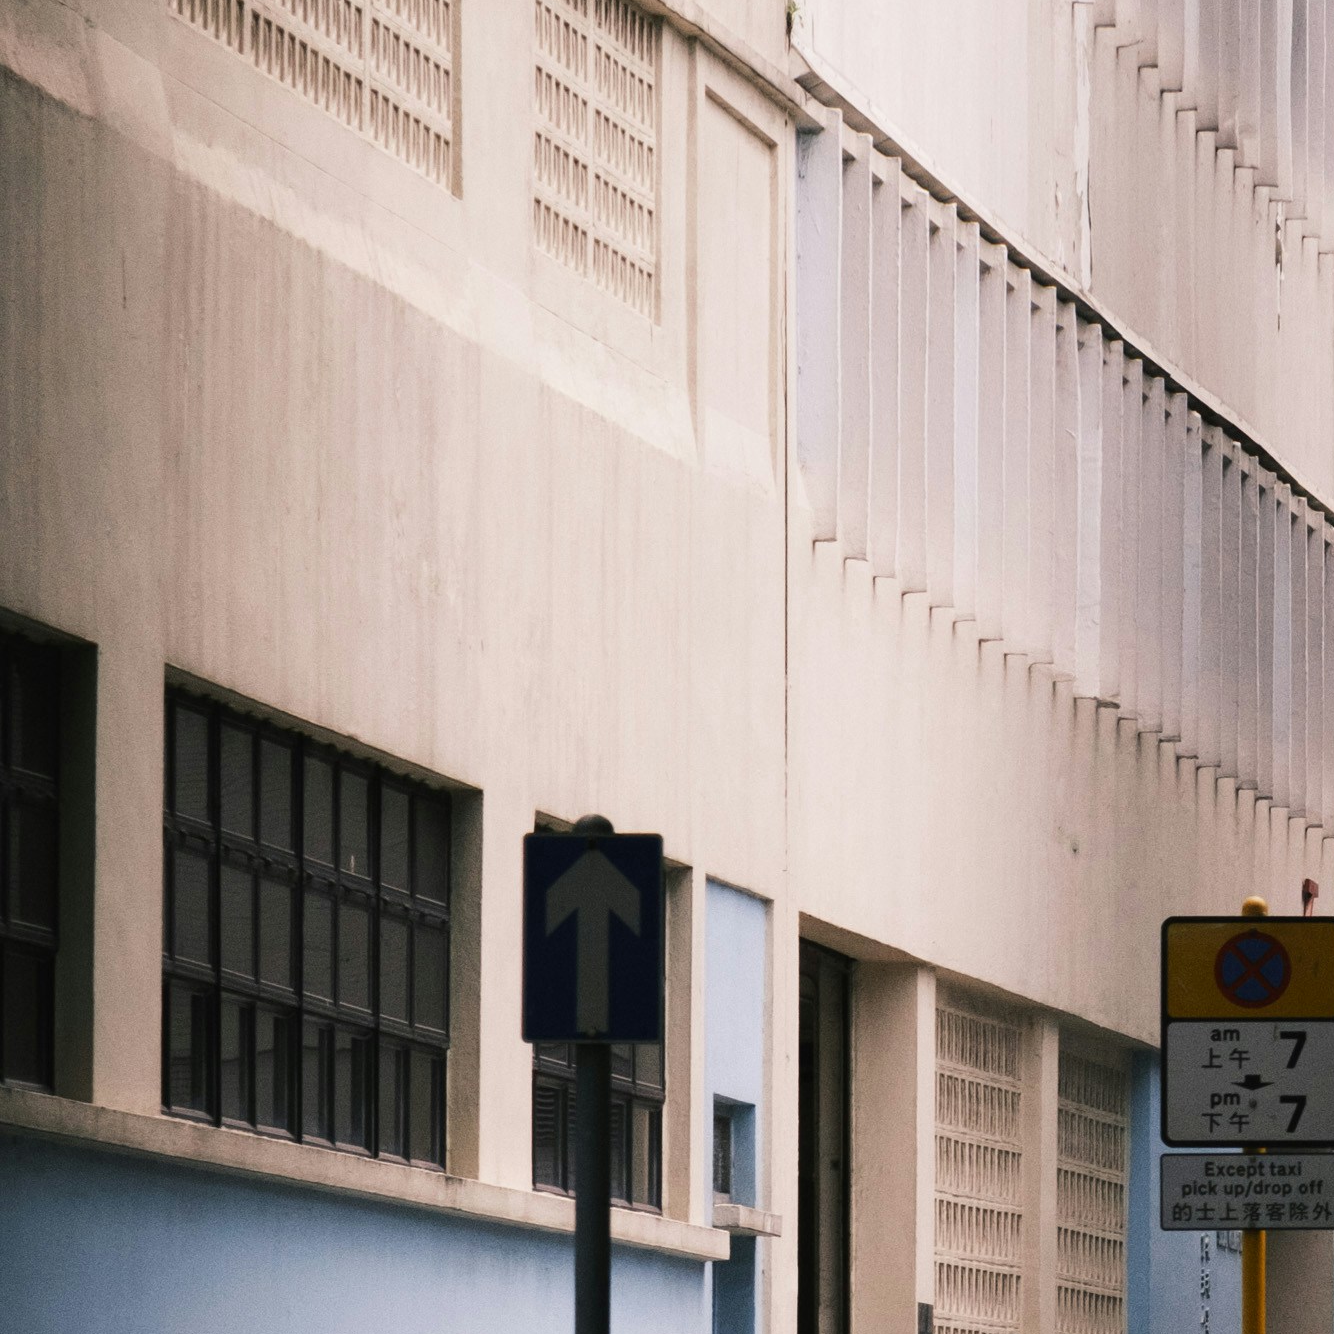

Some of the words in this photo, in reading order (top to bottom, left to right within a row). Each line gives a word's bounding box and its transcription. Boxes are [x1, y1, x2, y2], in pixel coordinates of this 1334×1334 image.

[1210, 1027, 1240, 1042] am
[1202, 1047, 1250, 1069] 上午
[1278, 1030, 1307, 1069] 7
[1210, 1092, 1240, 1107] pm
[1202, 1112, 1250, 1134] 下午
[1278, 1095, 1307, 1134] 7
[1204, 1161, 1265, 1178] Except
[1270, 1161, 1302, 1177] taxi
[1181, 1180, 1217, 1198] pick
[1223, 1180, 1292, 1198] up/drop
[1298, 1179, 1323, 1194] off
[1172, 1201, 1332, 1222] 的士上落客除外
